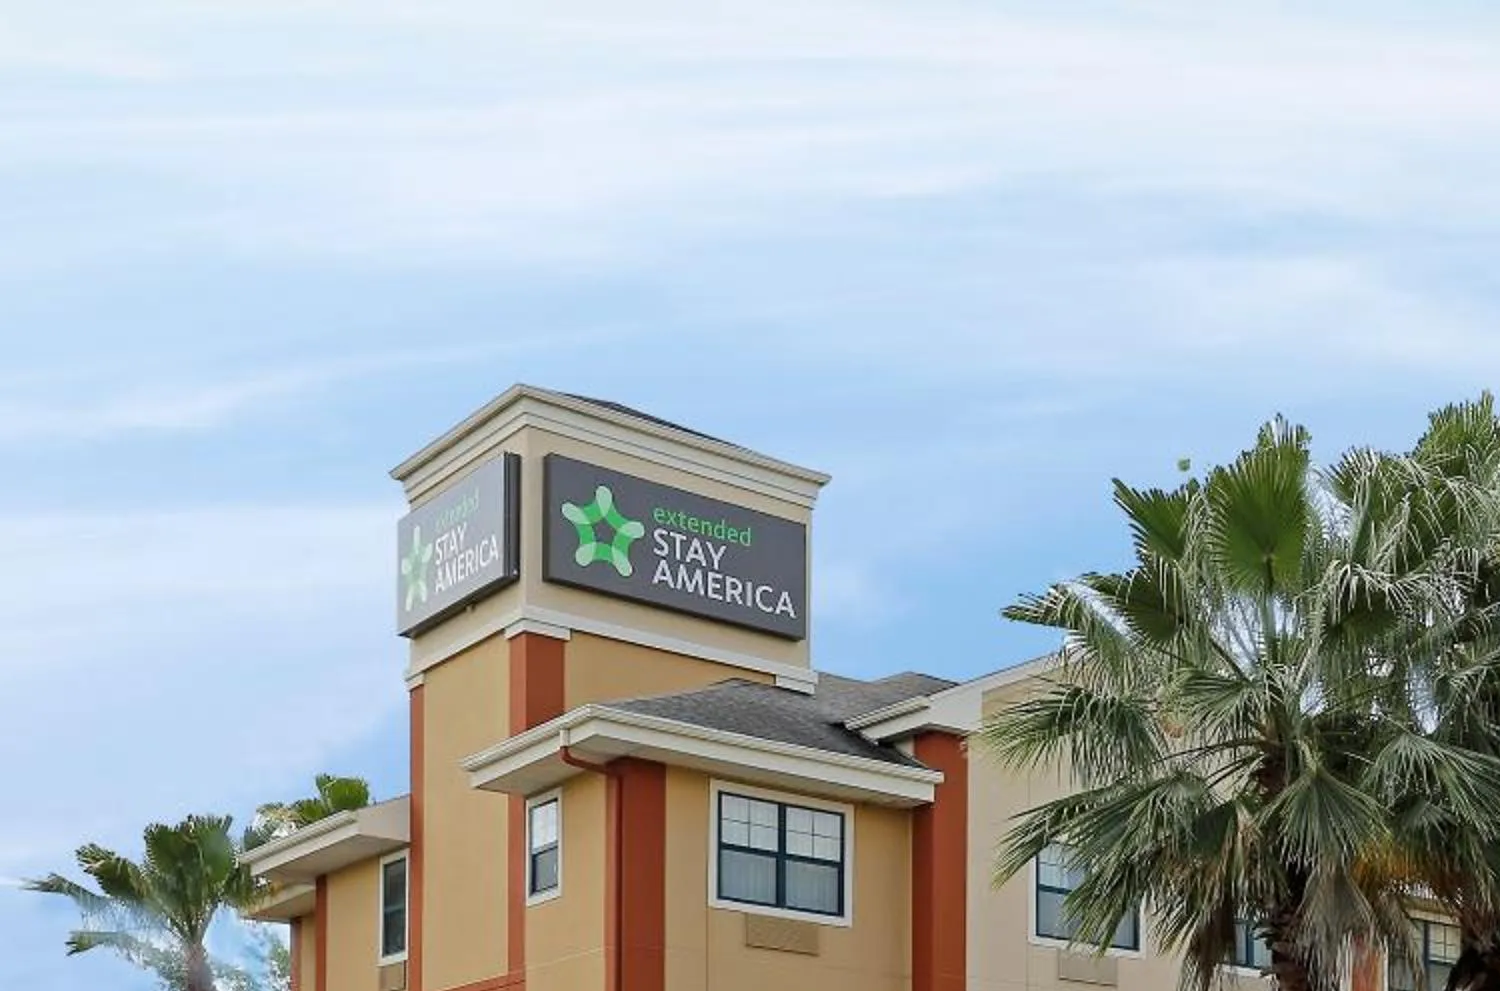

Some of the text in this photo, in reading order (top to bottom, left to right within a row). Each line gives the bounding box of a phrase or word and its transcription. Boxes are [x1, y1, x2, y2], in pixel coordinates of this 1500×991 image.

[435, 522, 467, 562] STAY
[653, 508, 751, 546] extended
[435, 534, 499, 594] AMERICA
[653, 528, 727, 570] STAY
[652, 560, 796, 618] AMERICA
